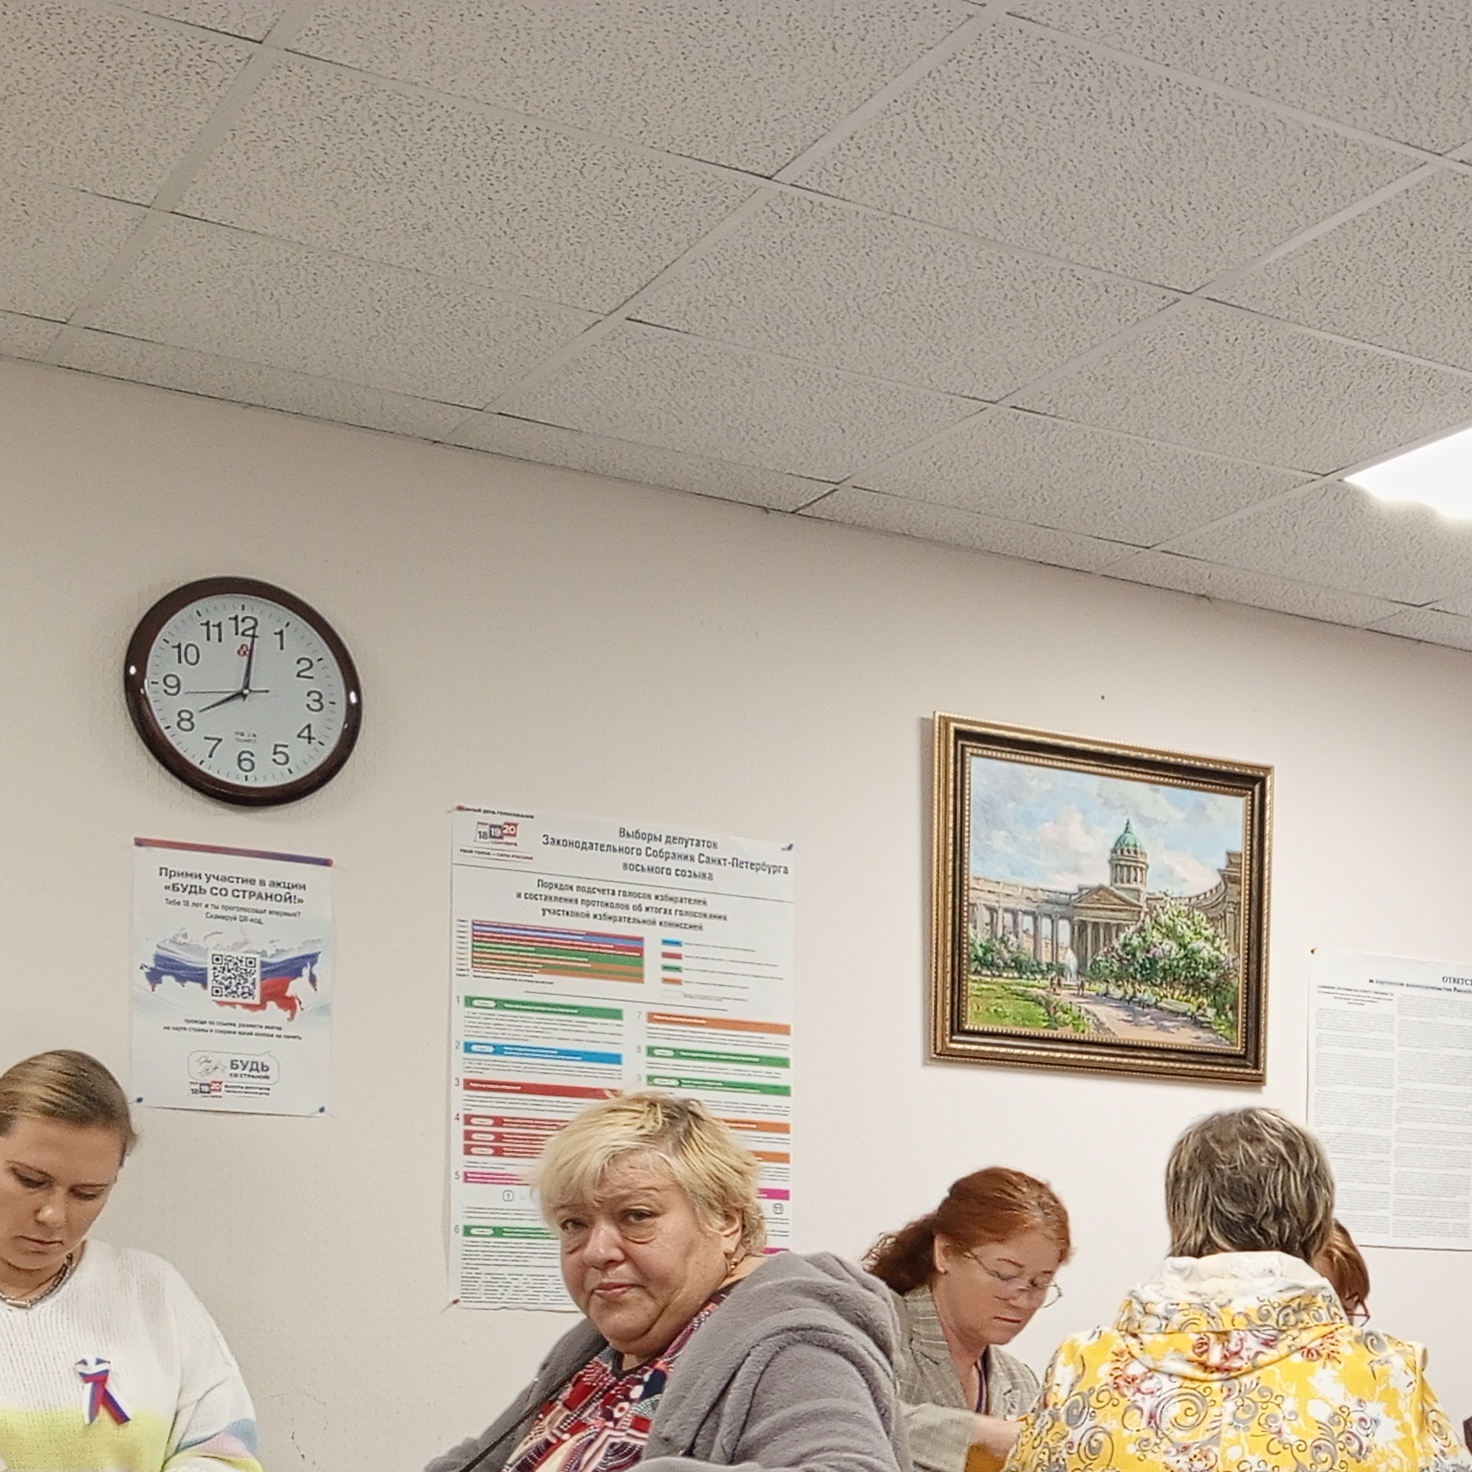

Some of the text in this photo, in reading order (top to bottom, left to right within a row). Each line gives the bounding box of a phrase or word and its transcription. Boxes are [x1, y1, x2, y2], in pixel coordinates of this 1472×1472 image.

[200, 620, 222, 643] 11
[228, 614, 259, 638] 12
[273, 629, 284, 650] 1
[171, 642, 200, 666] 10
[296, 657, 314, 679] 2
[163, 673, 182, 697] 9
[306, 690, 324, 712] 3
[176, 709, 195, 732] 8
[296, 723, 316, 745] 4
[204, 736, 223, 758] 7
[272, 743, 290, 766] 5
[237, 750, 255, 773] 6
[478, 830, 488, 840] 18
[490, 826, 501, 838] 19
[503, 824, 516, 835] 20
[619, 827, 718, 850] Выборы депутатов
[542, 834, 789, 875] Законодательного Собрания Санкт-Петербурга
[159, 866, 306, 891] Прими участие в акции
[622, 862, 714, 881] восьмого созыва
[164, 882, 304, 904] «БУДЬ СО СТРАНОЙ!»
[537, 878, 708, 907] Порядок подсчета голосов избирателей
[524, 892, 578, 904] составления
[580, 898, 630, 910] протоколов
[632, 904, 642, 912] об
[644, 906, 672, 916] итогах
[674, 908, 728, 921] голосования
[542, 908, 704, 932] участковой избирательной комиссией
[456, 996, 460, 1004] 1
[455, 1041, 460, 1050] 2
[230, 1059, 270, 1073] БУДЬ
[454, 1078, 460, 1086] 3
[454, 1114, 460, 1122] 4
[454, 1171, 460, 1180] 5
[454, 1225, 460, 1234] 6
